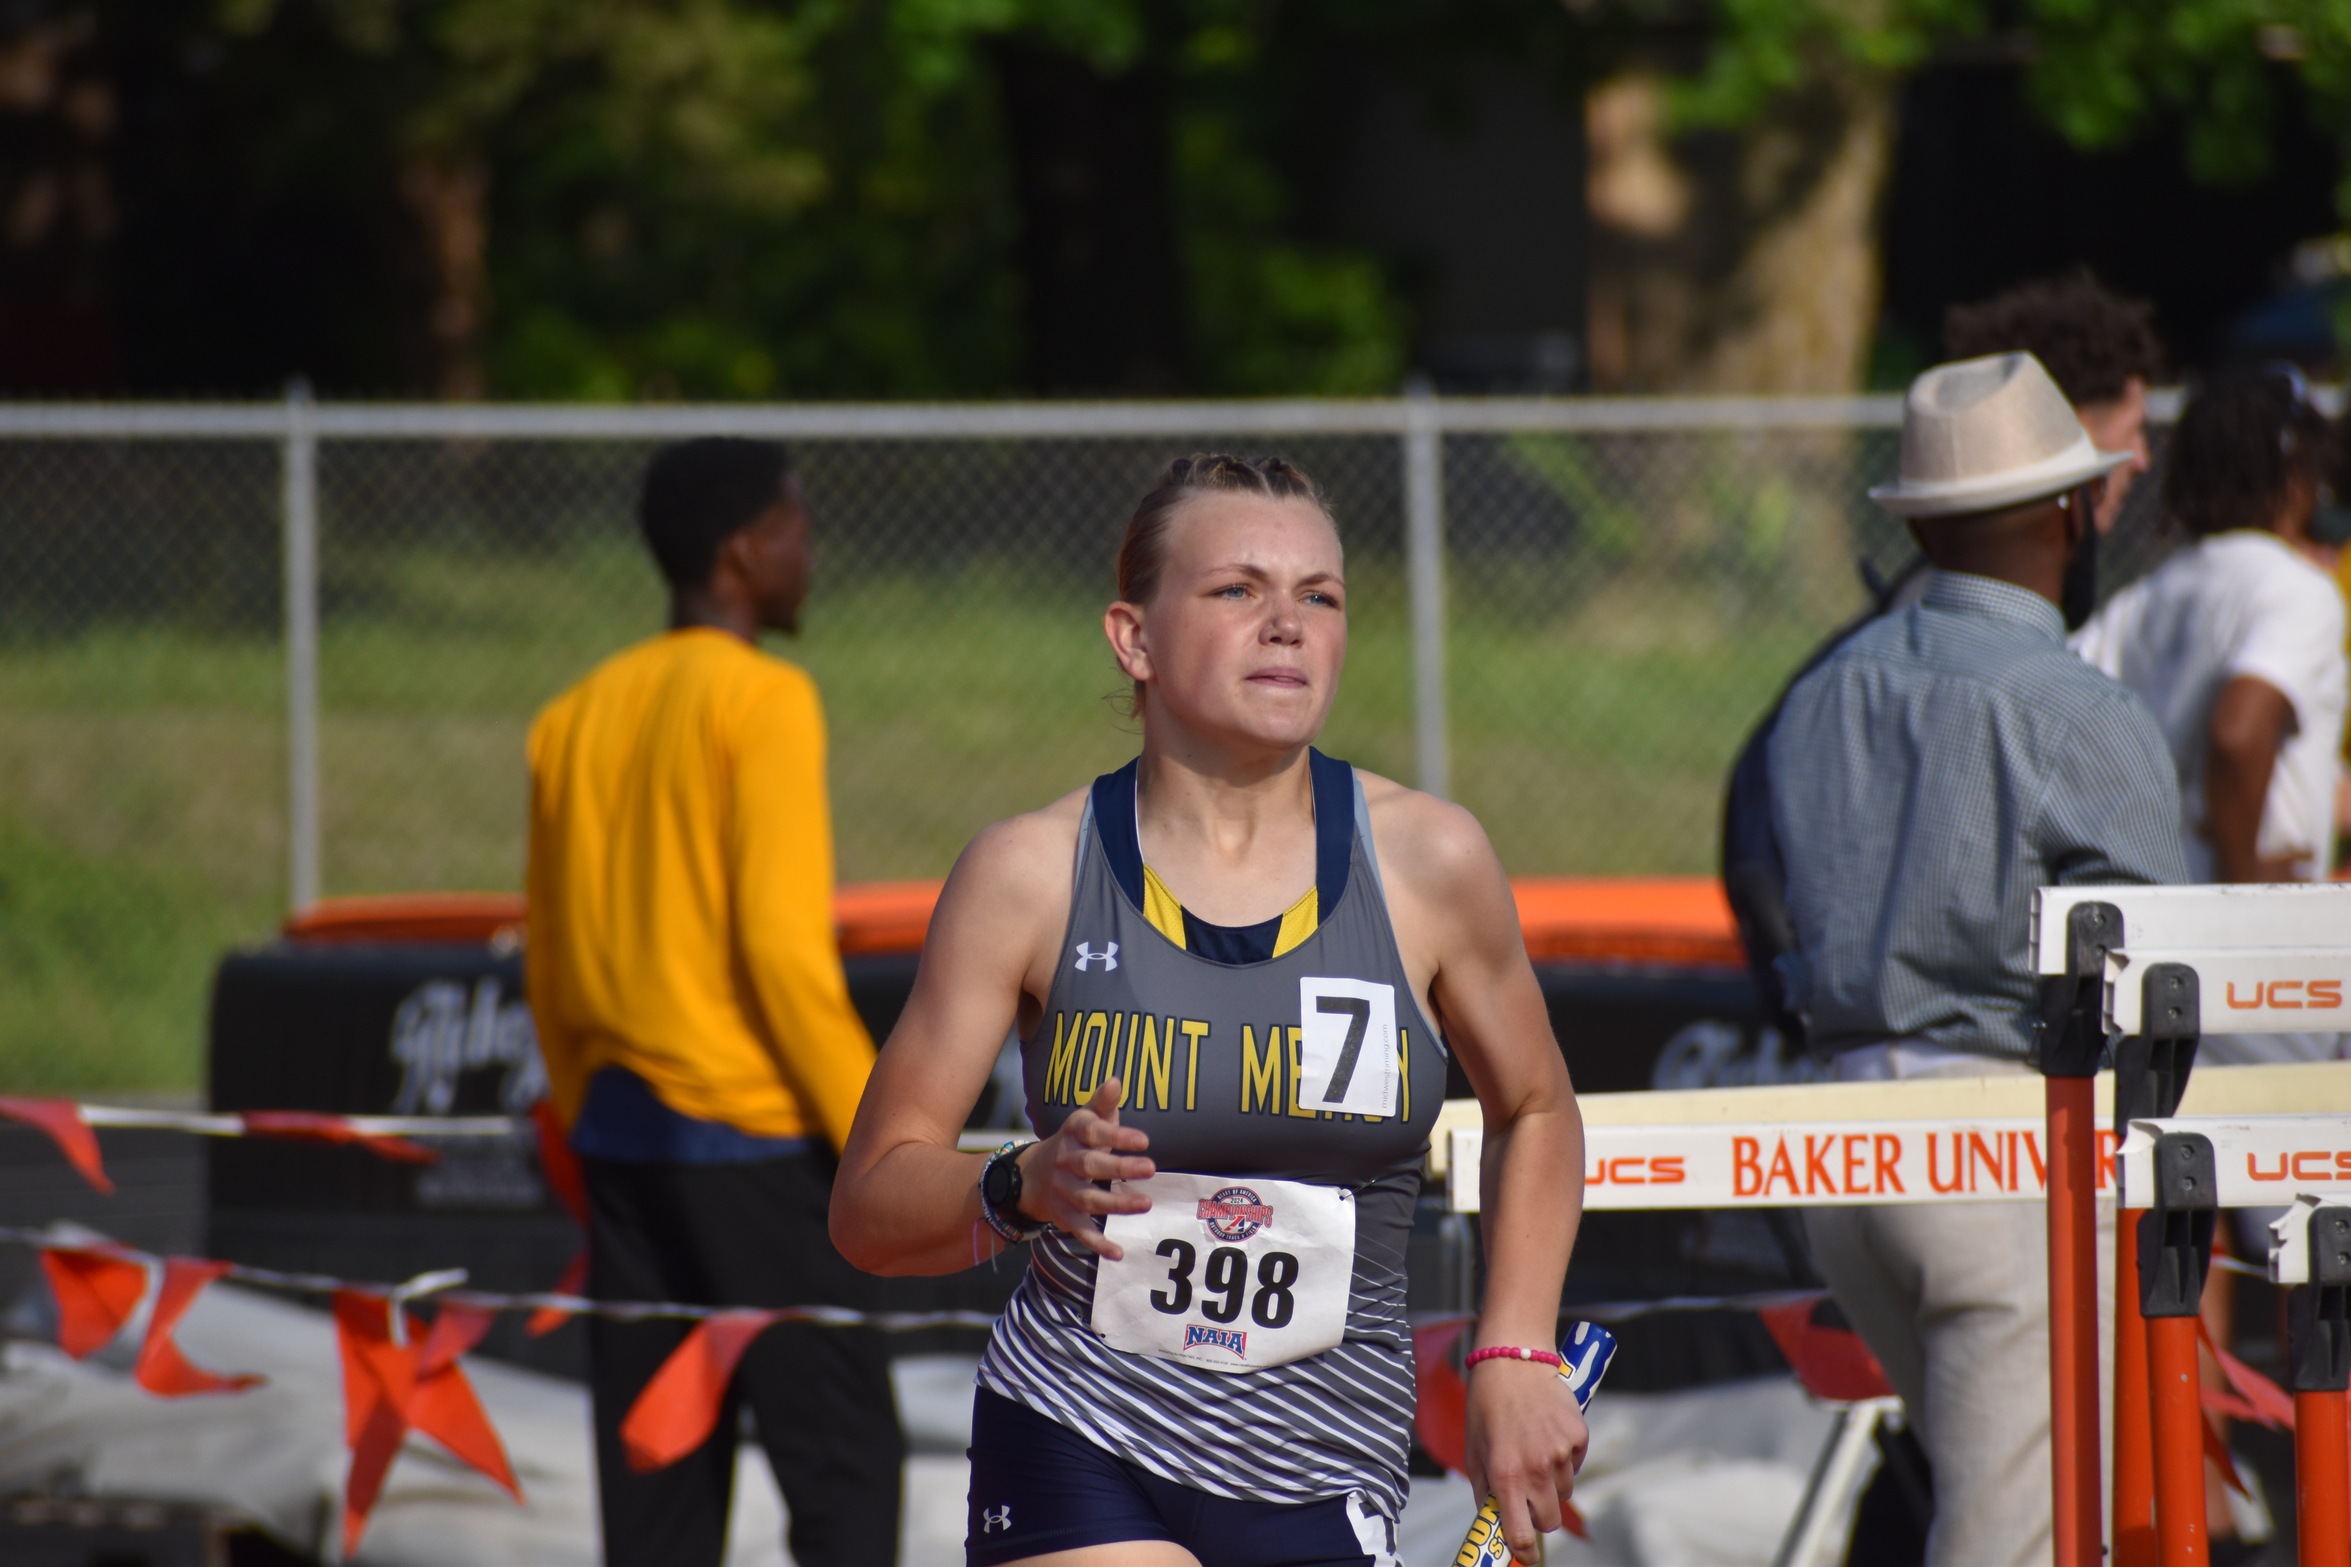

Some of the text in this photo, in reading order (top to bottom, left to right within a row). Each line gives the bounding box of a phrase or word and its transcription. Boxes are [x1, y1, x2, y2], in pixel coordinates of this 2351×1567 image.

[2226, 980, 2342, 1009] UCS
[1044, 1010, 1410, 1124] MOUNT MEY
[1316, 995, 1371, 1104] 7
[1733, 1131, 1906, 1197] BAKER
[1197, 1199, 1273, 1228] CHAMPIONSHIPS
[1150, 1238, 1299, 1329] 398
[1186, 1326, 1243, 1354] NAIA
